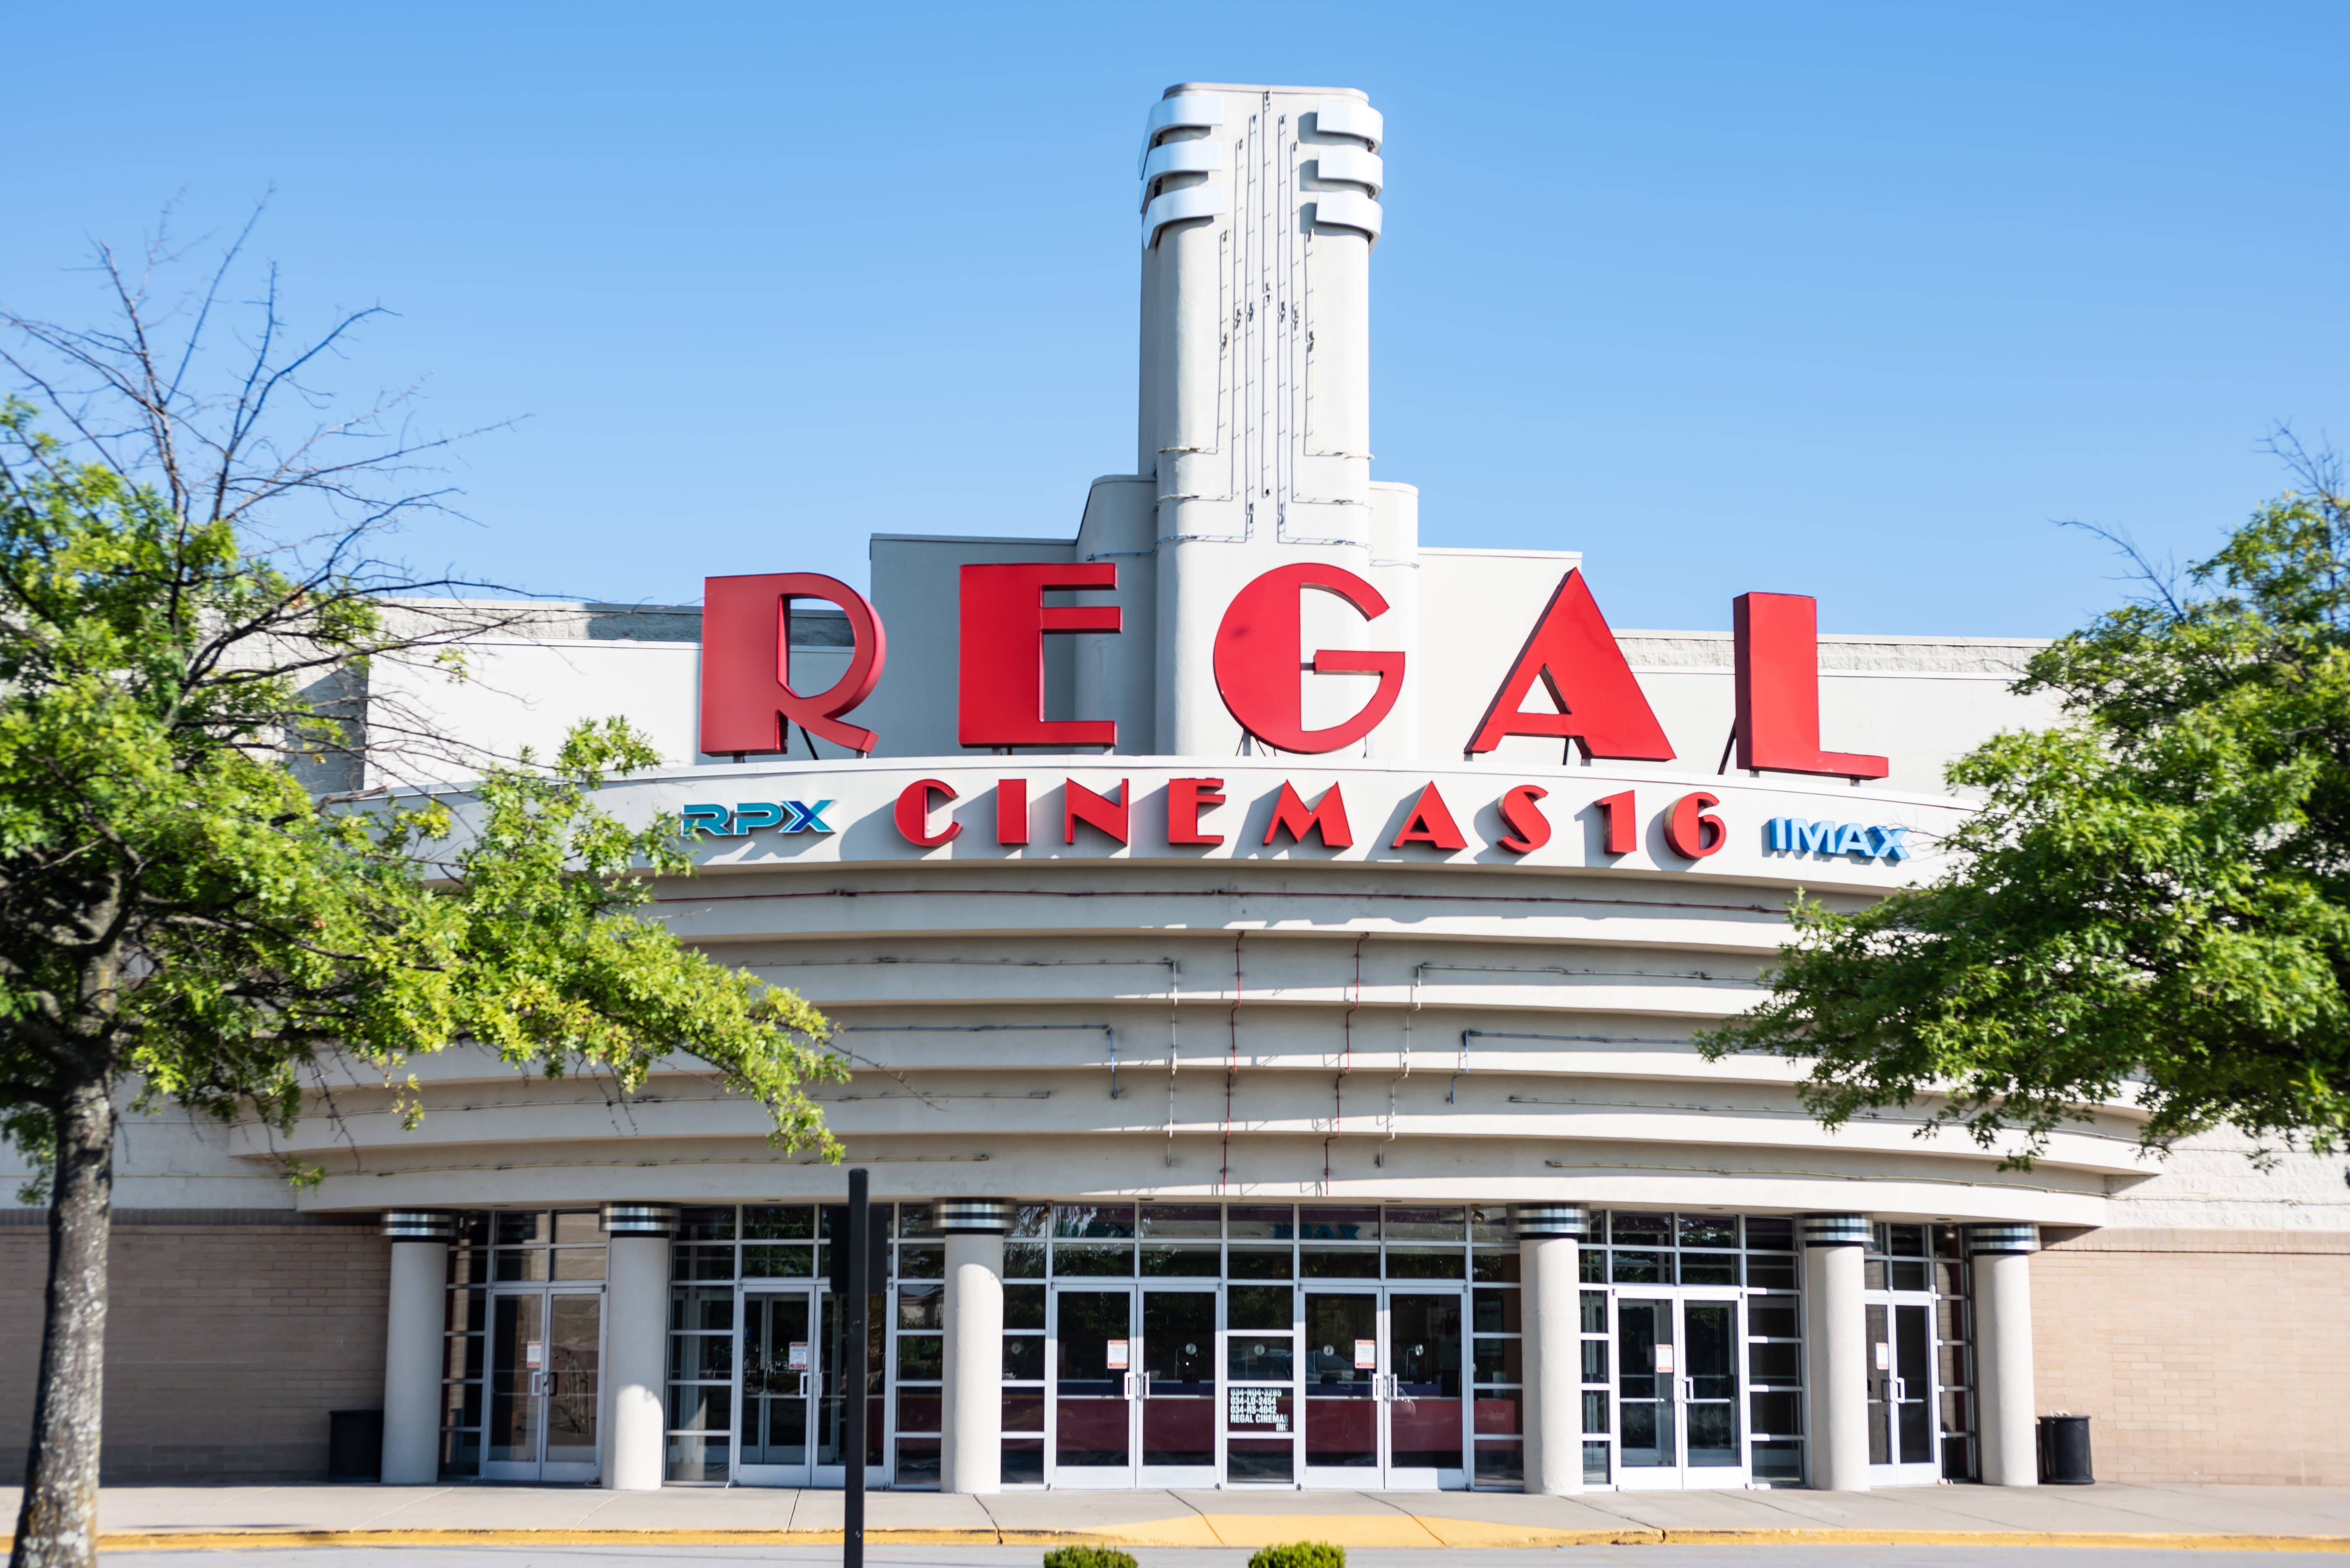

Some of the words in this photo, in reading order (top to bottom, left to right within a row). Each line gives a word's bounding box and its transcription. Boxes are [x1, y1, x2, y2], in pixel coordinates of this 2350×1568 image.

[700, 562, 1889, 780] REGAL
[681, 800, 836, 836] RPX
[894, 778, 1551, 855] CINEMAS
[1595, 790, 1726, 860] 16
[1770, 817, 1911, 860] IMAX
[1231, 1414, 1254, 1423] REGAL
[1256, 1414, 1288, 1423] CINEMAS
[1276, 1423, 1288, 1432] INC
